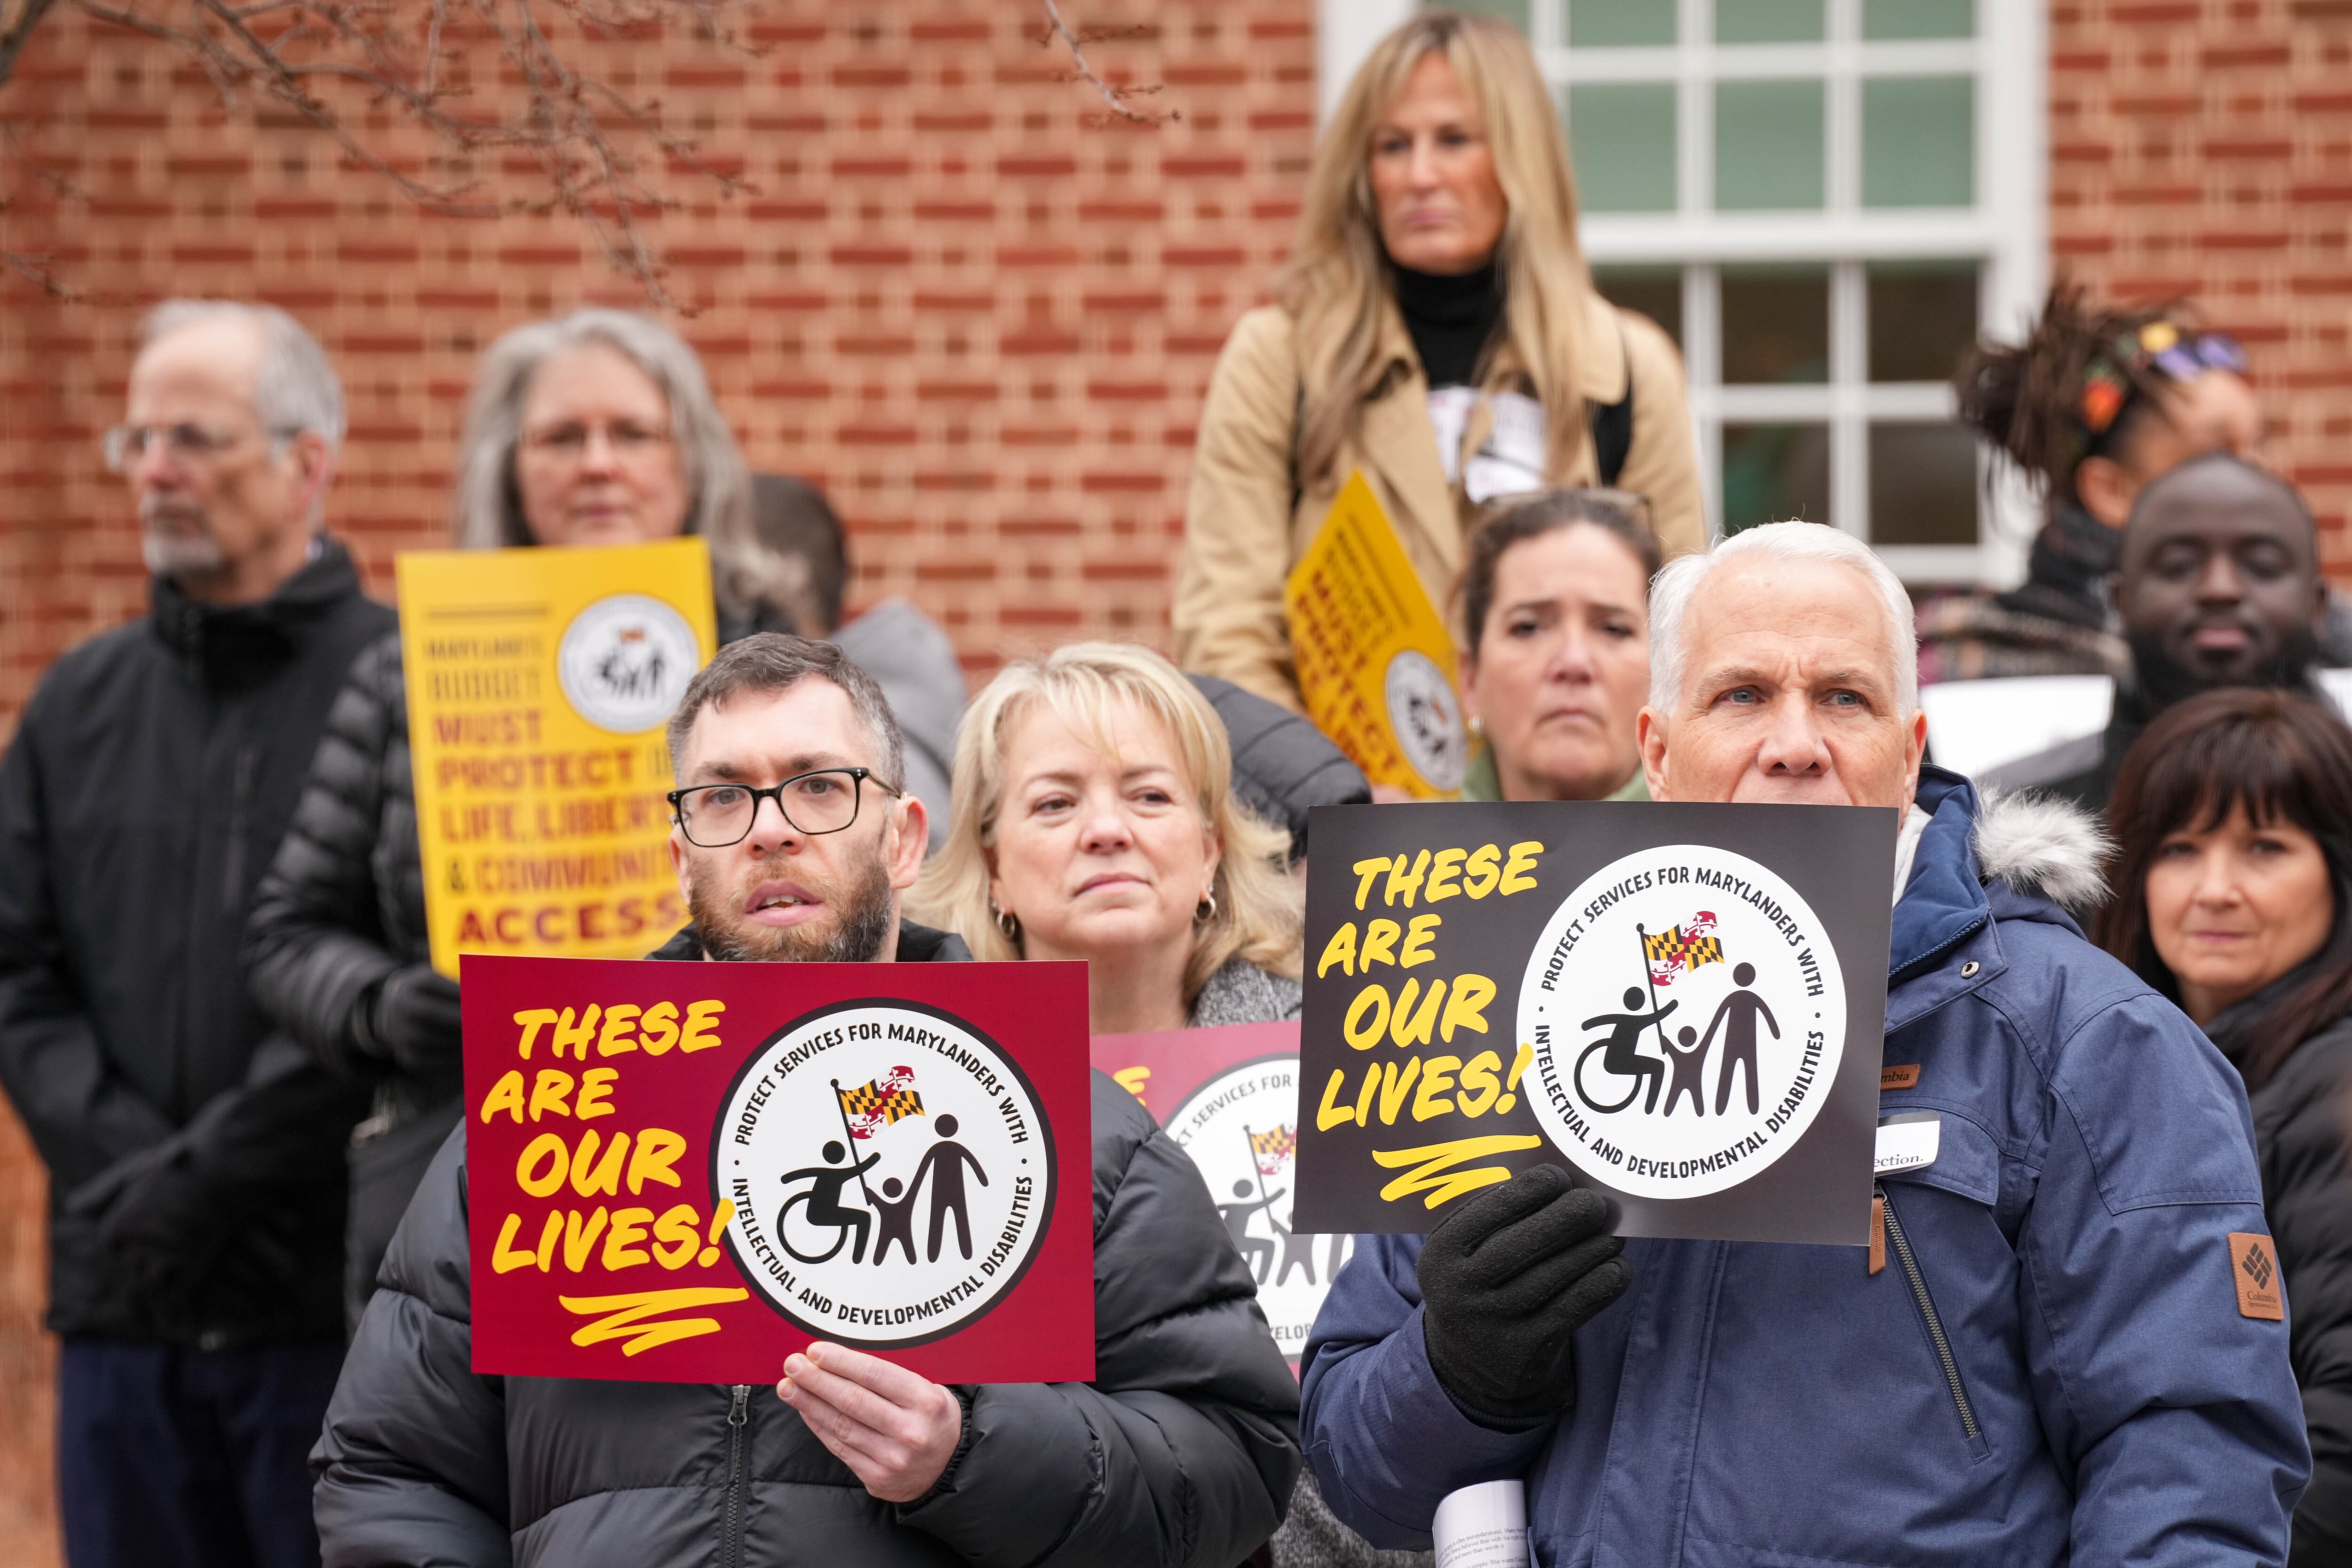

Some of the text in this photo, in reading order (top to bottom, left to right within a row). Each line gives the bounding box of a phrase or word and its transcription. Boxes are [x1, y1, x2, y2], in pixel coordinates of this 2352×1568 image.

[435, 708, 541, 745] MUST
[438, 749, 633, 789] PROTECT
[536, 792, 672, 838] LIBERT
[476, 843, 675, 894] COMMUNIT
[1353, 841, 1544, 911] THESE
[459, 891, 682, 947] ACCESS
[1317, 914, 1442, 979] ARE
[1541, 866, 1824, 997] PROTECT SERVICES FOR MARYLANDERS WITH
[514, 1000, 725, 1060] THESE
[1343, 974, 1497, 1051] OUR
[481, 1067, 619, 1123] ARE
[734, 1022, 1029, 1146] PROTECT SERVICES FOR MARYLANDERS WITH
[1192, 1073, 1291, 1129] SERVICES FOR
[1317, 1043, 1534, 1132] LIVES!
[1535, 1025, 1824, 1179] INTELLECTUAL AND DEVELOPMENTAL DISABILITIES
[1881, 1071, 1909, 1083] mbia
[517, 1128, 686, 1197] OUR
[1874, 1154, 1924, 1167] ection.
[493, 1198, 735, 1274] LIVES!
[732, 1176, 1033, 1326] INTELLECTUAL AND DEVELOPMENTAL DISABILITIES
[1461, 1541, 1479, 1550] believes
